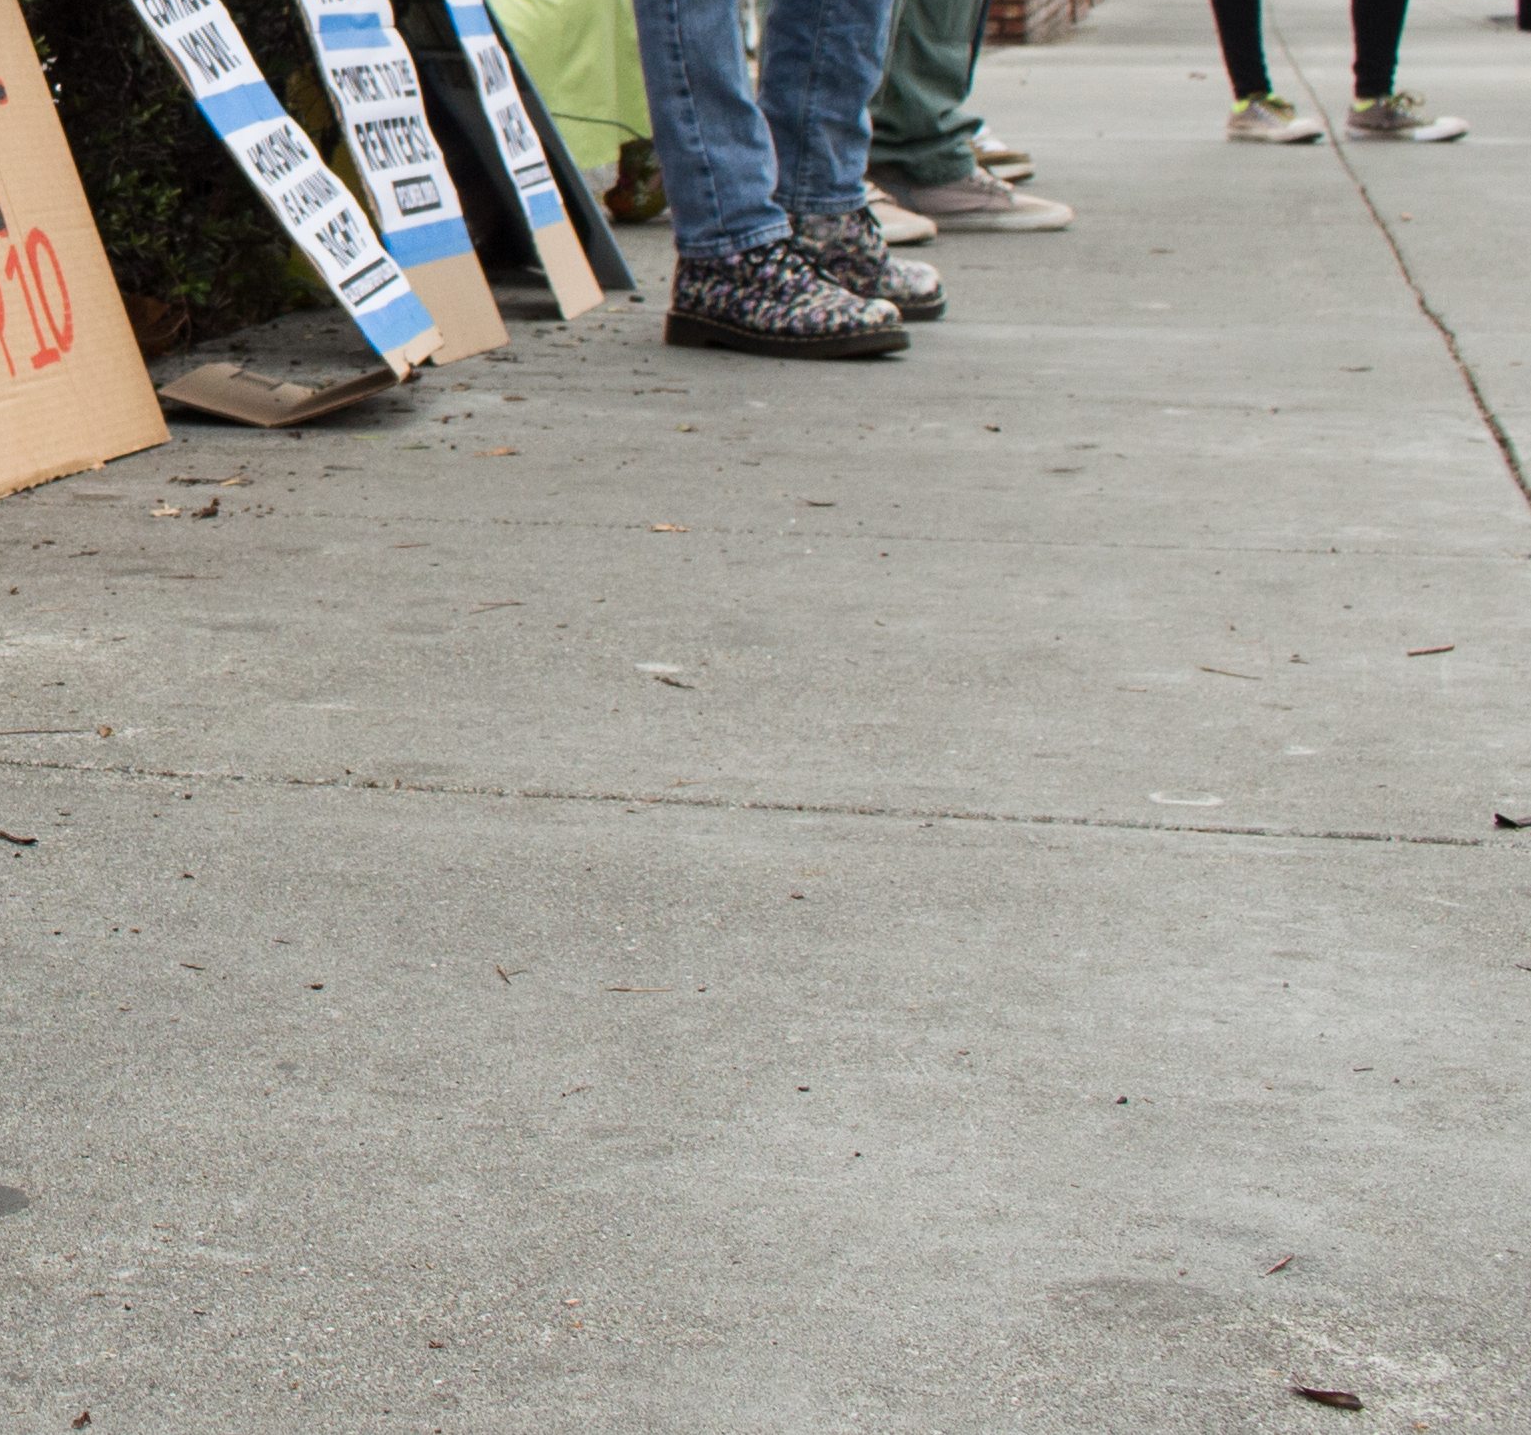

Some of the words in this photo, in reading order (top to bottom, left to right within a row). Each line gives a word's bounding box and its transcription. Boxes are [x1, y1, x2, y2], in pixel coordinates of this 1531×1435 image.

[178, 21, 243, 84] NOW!
[354, 115, 438, 173] RENTERS!
[6, 228, 75, 370] 10
